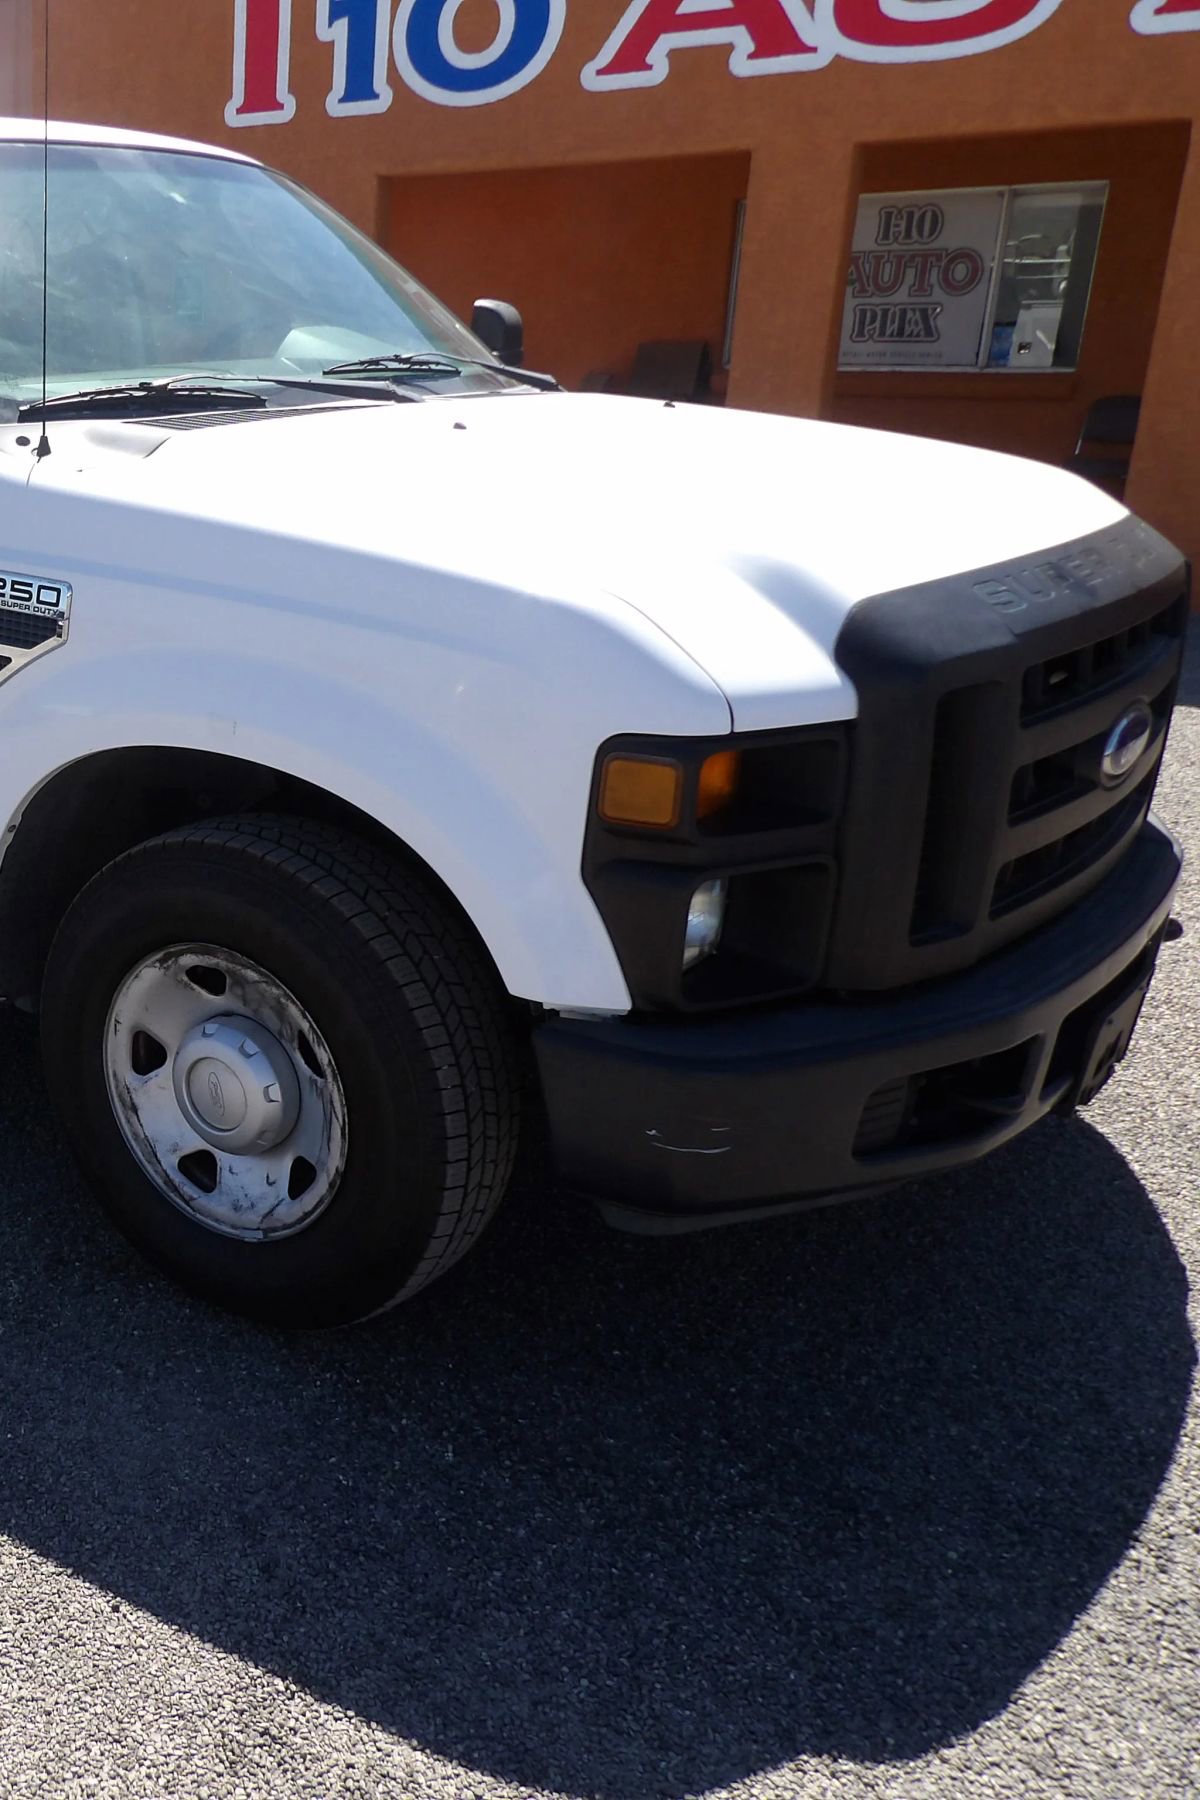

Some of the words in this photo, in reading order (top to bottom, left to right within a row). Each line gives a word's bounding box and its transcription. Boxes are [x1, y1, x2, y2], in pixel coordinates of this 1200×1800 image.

[848, 248, 984, 298] AUTO
[850, 303, 943, 342] PLEX
[0, 599, 31, 611] SUPER
[32, 605, 60, 617] DUTY
